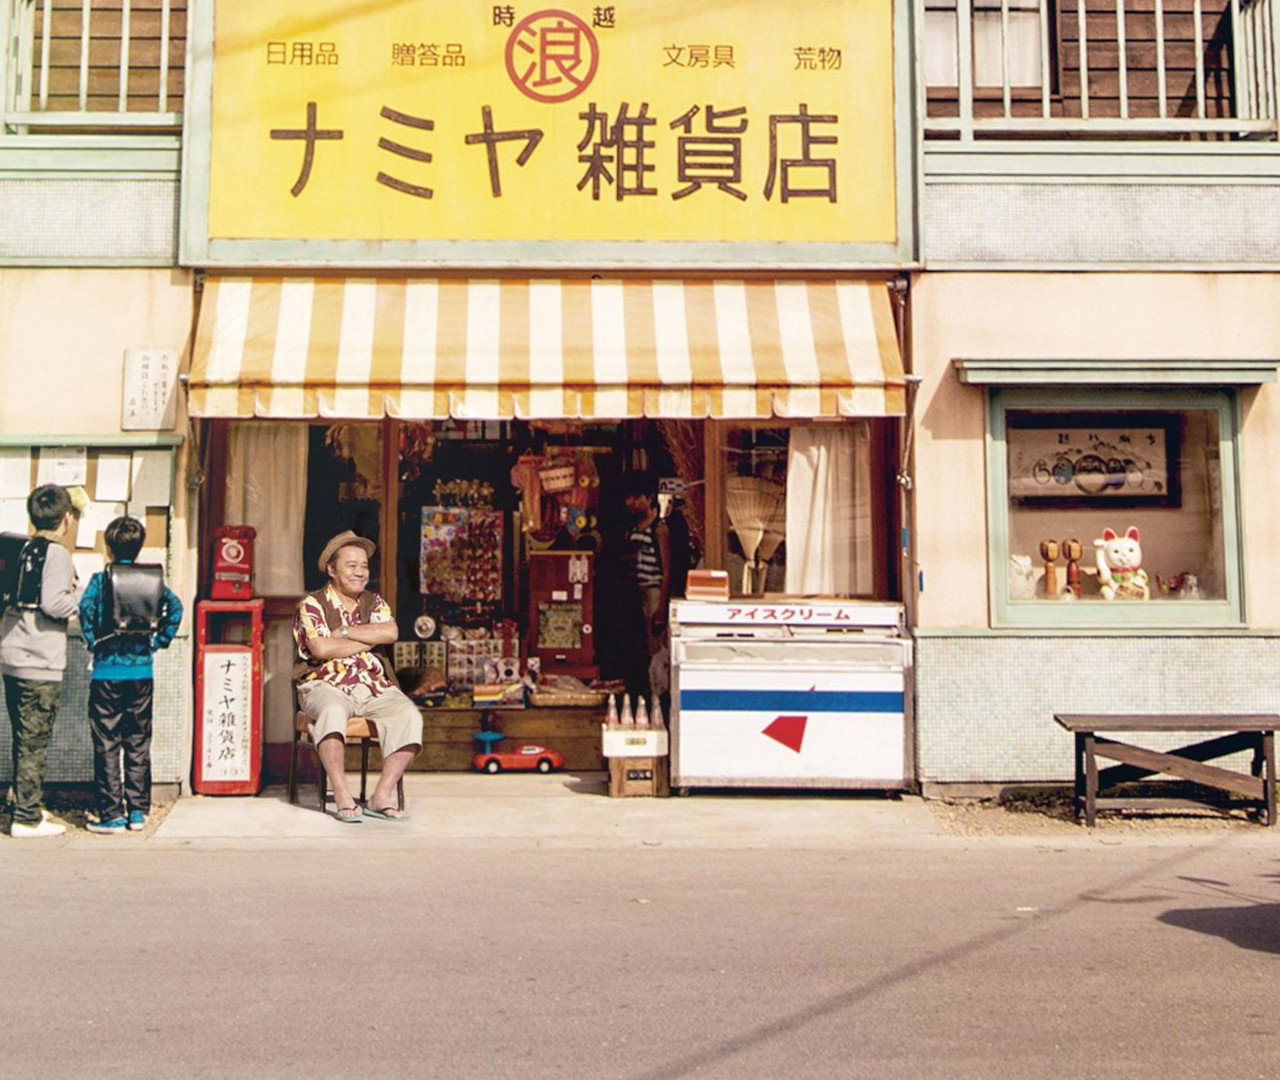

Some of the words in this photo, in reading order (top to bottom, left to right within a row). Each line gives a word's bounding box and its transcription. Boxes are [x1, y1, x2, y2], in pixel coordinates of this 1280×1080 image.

[492, 5, 517, 28] 時
[591, 5, 616, 29] 越
[266, 41, 339, 66] 日用品
[391, 42, 466, 67] 贈答品
[662, 44, 735, 69] 文房具
[794, 46, 842, 70] 荒物
[515, 19, 590, 92] 浪
[269, 100, 839, 204] ナミヤ雑貨店
[726, 607, 851, 621] アイスクリーム
[218, 659, 237, 761] ナミヤ雑貨店
